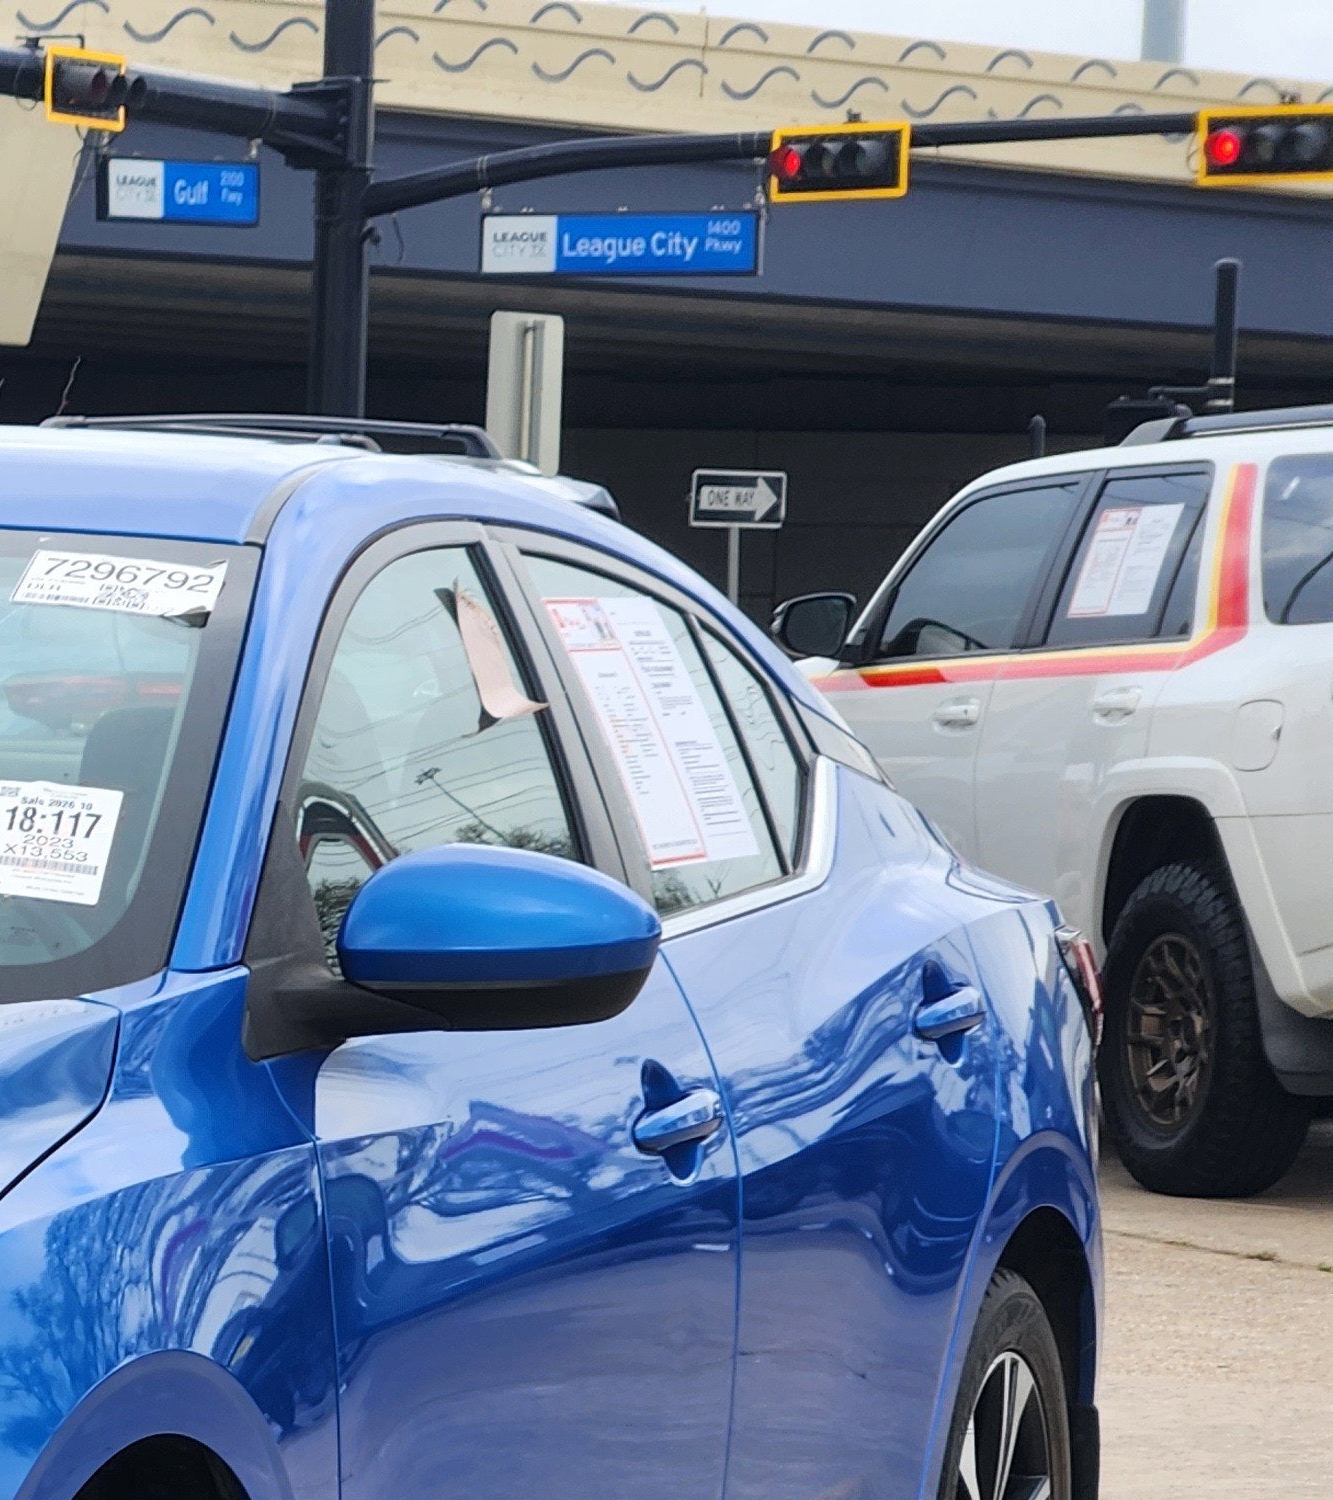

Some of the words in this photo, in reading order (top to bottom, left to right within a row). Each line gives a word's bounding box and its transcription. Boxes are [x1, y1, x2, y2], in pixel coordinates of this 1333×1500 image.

[115, 174, 156, 188] LEAGUE
[173, 178, 209, 206] Gulf
[707, 220, 741, 235] 1400
[492, 231, 548, 244] LEAGUE
[705, 237, 742, 254] Pkwy
[562, 232, 646, 264] League
[650, 230, 698, 261] City
[707, 488, 730, 507] ONE
[732, 488, 754, 507] WAY
[44, 557, 215, 593] 7296792
[21, 796, 44, 806] Sale
[5, 805, 102, 839] 18:117
[23, 834, 74, 849] 2023
